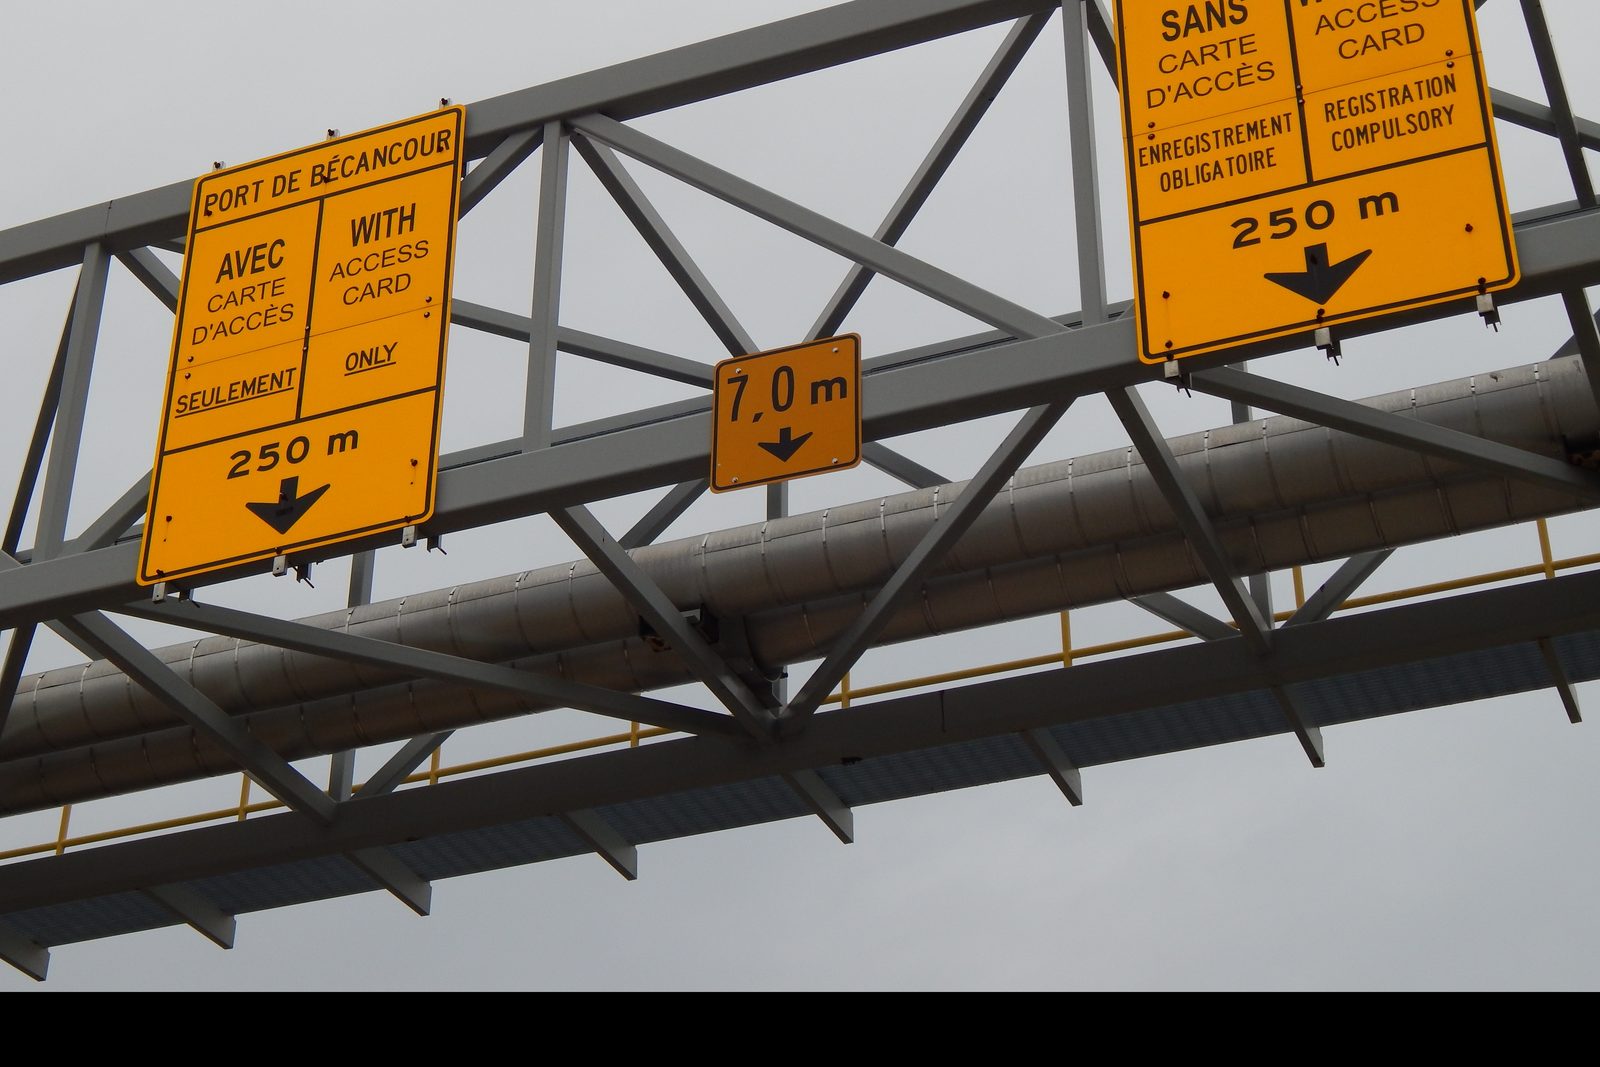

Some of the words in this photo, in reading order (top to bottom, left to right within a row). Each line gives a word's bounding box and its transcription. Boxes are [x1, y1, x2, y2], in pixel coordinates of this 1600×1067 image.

[1161, 0, 1249, 42] SANS
[1338, 23, 1425, 60] CARD
[1158, 33, 1258, 74] CARTE
[1146, 61, 1275, 109] D'ACCÈS
[1325, 73, 1457, 123] REGISTRATION
[1138, 112, 1292, 168] ENREGISTREMENT
[1331, 104, 1454, 152] COMPULSORY
[203, 180, 265, 217] PORT
[271, 169, 302, 199] DE
[310, 128, 451, 187] BÉCANCOUR
[1160, 147, 1277, 192] OBLIGATOIRE
[351, 203, 416, 247] WITH
[1230, 200, 1335, 249] 250
[1358, 191, 1400, 220] m
[216, 239, 286, 284] AVEC
[329, 240, 429, 282] ACCESS
[207, 277, 286, 313] CARTE
[342, 273, 412, 306] CARD
[192, 303, 294, 346] D'ACCÈS
[345, 342, 398, 374] ONLY
[175, 367, 297, 415] SEULEMENT
[727, 365, 795, 423] 7,0
[810, 376, 848, 405] m
[227, 435, 311, 480] 250
[327, 429, 359, 456] m
